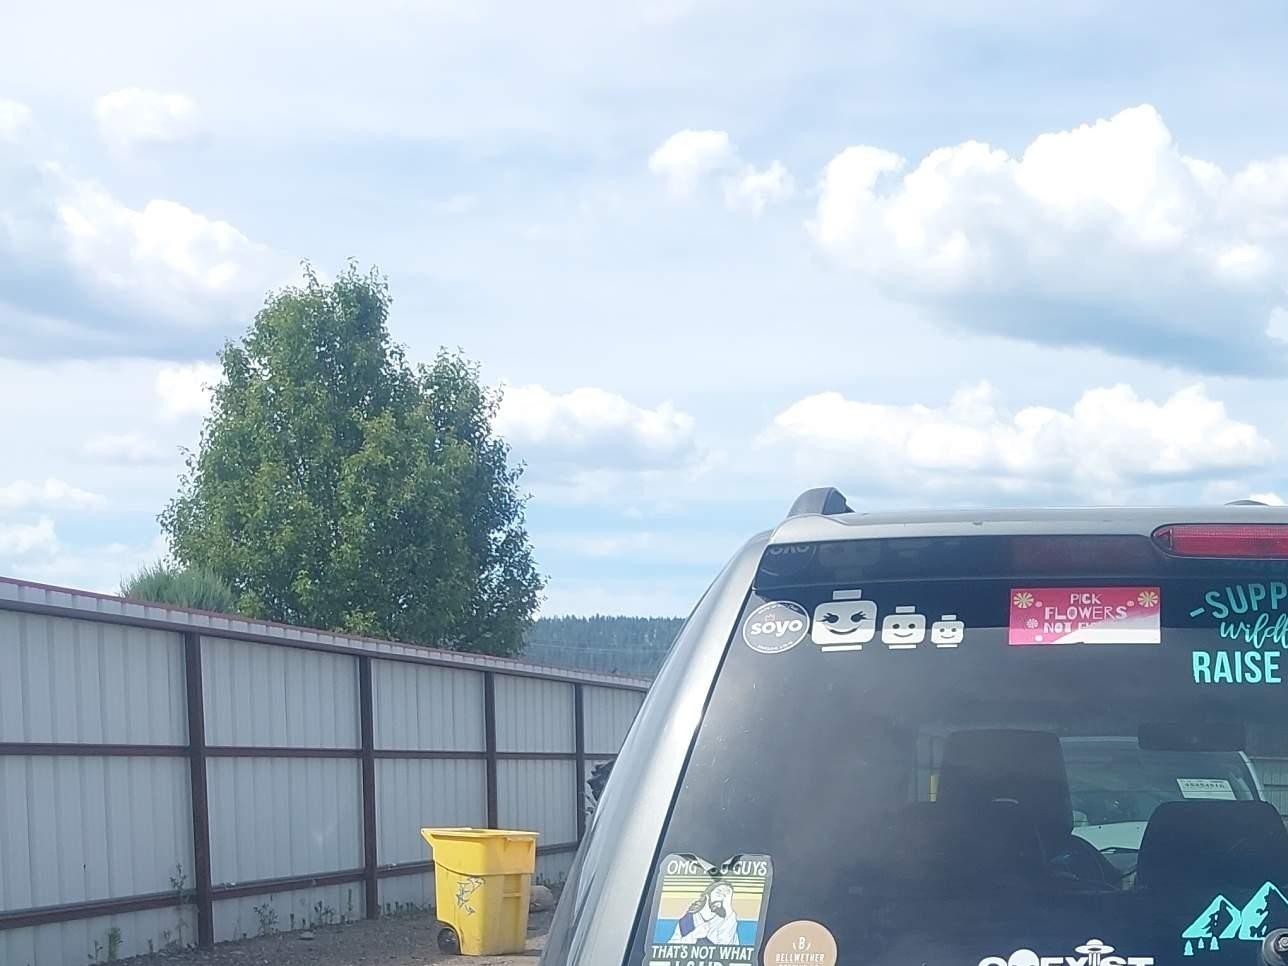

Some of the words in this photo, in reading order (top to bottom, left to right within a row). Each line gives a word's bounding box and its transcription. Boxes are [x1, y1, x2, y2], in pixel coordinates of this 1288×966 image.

[1070, 593, 1103, 605] PICK
[1044, 606, 1128, 620] FLOWERS
[1043, 622, 1073, 634] NOT
[1192, 651, 1282, 684] RAISE
[667, 860, 698, 875] OMG
[733, 860, 767, 876] GUYS
[652, 944, 688, 959] THAT'S
[690, 945, 716, 959] NOT
[719, 946, 755, 961] WHAT
